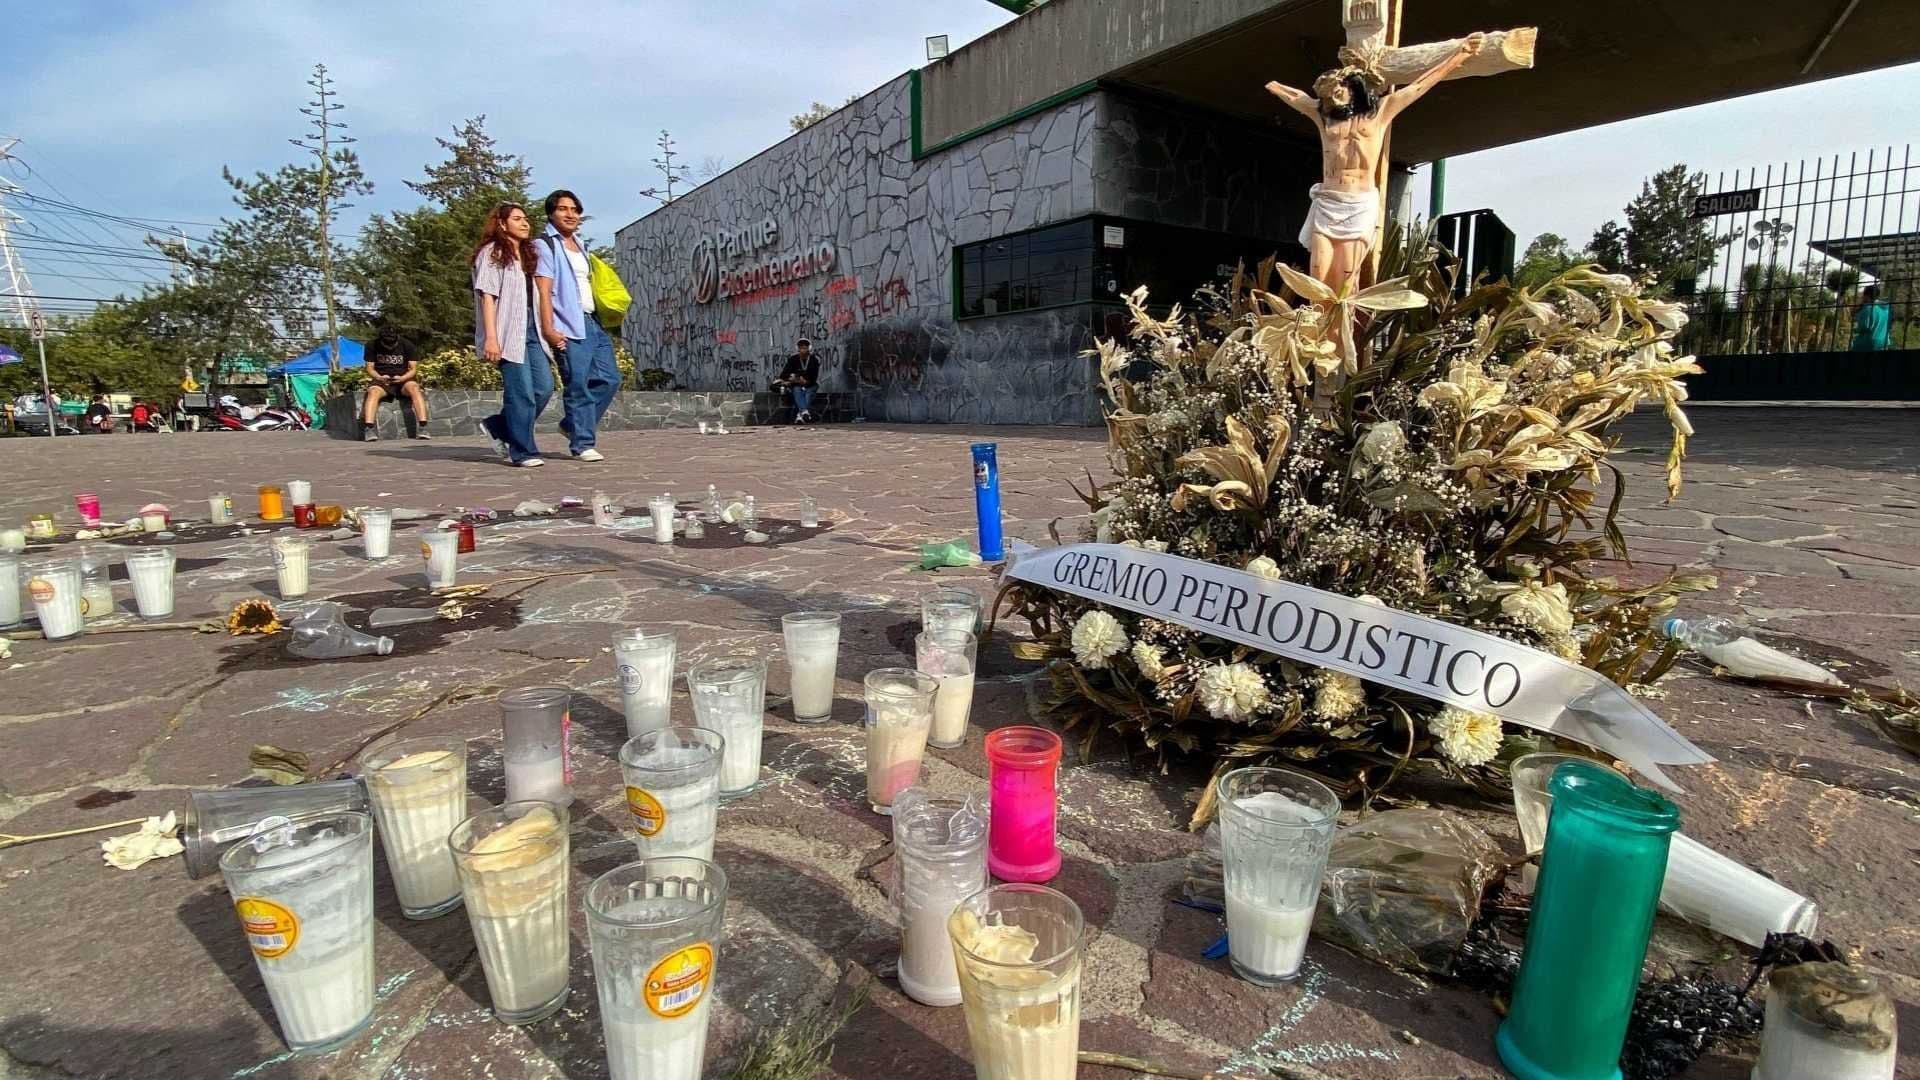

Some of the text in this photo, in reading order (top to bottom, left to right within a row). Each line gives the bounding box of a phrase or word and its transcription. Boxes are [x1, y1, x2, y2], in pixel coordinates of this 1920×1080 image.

[1698, 193, 1754, 214] SALIDA
[716, 215, 778, 260] Parque
[718, 241, 836, 299] Bicentenario
[1053, 550, 1523, 709] GREMIO PERIODISTICO
